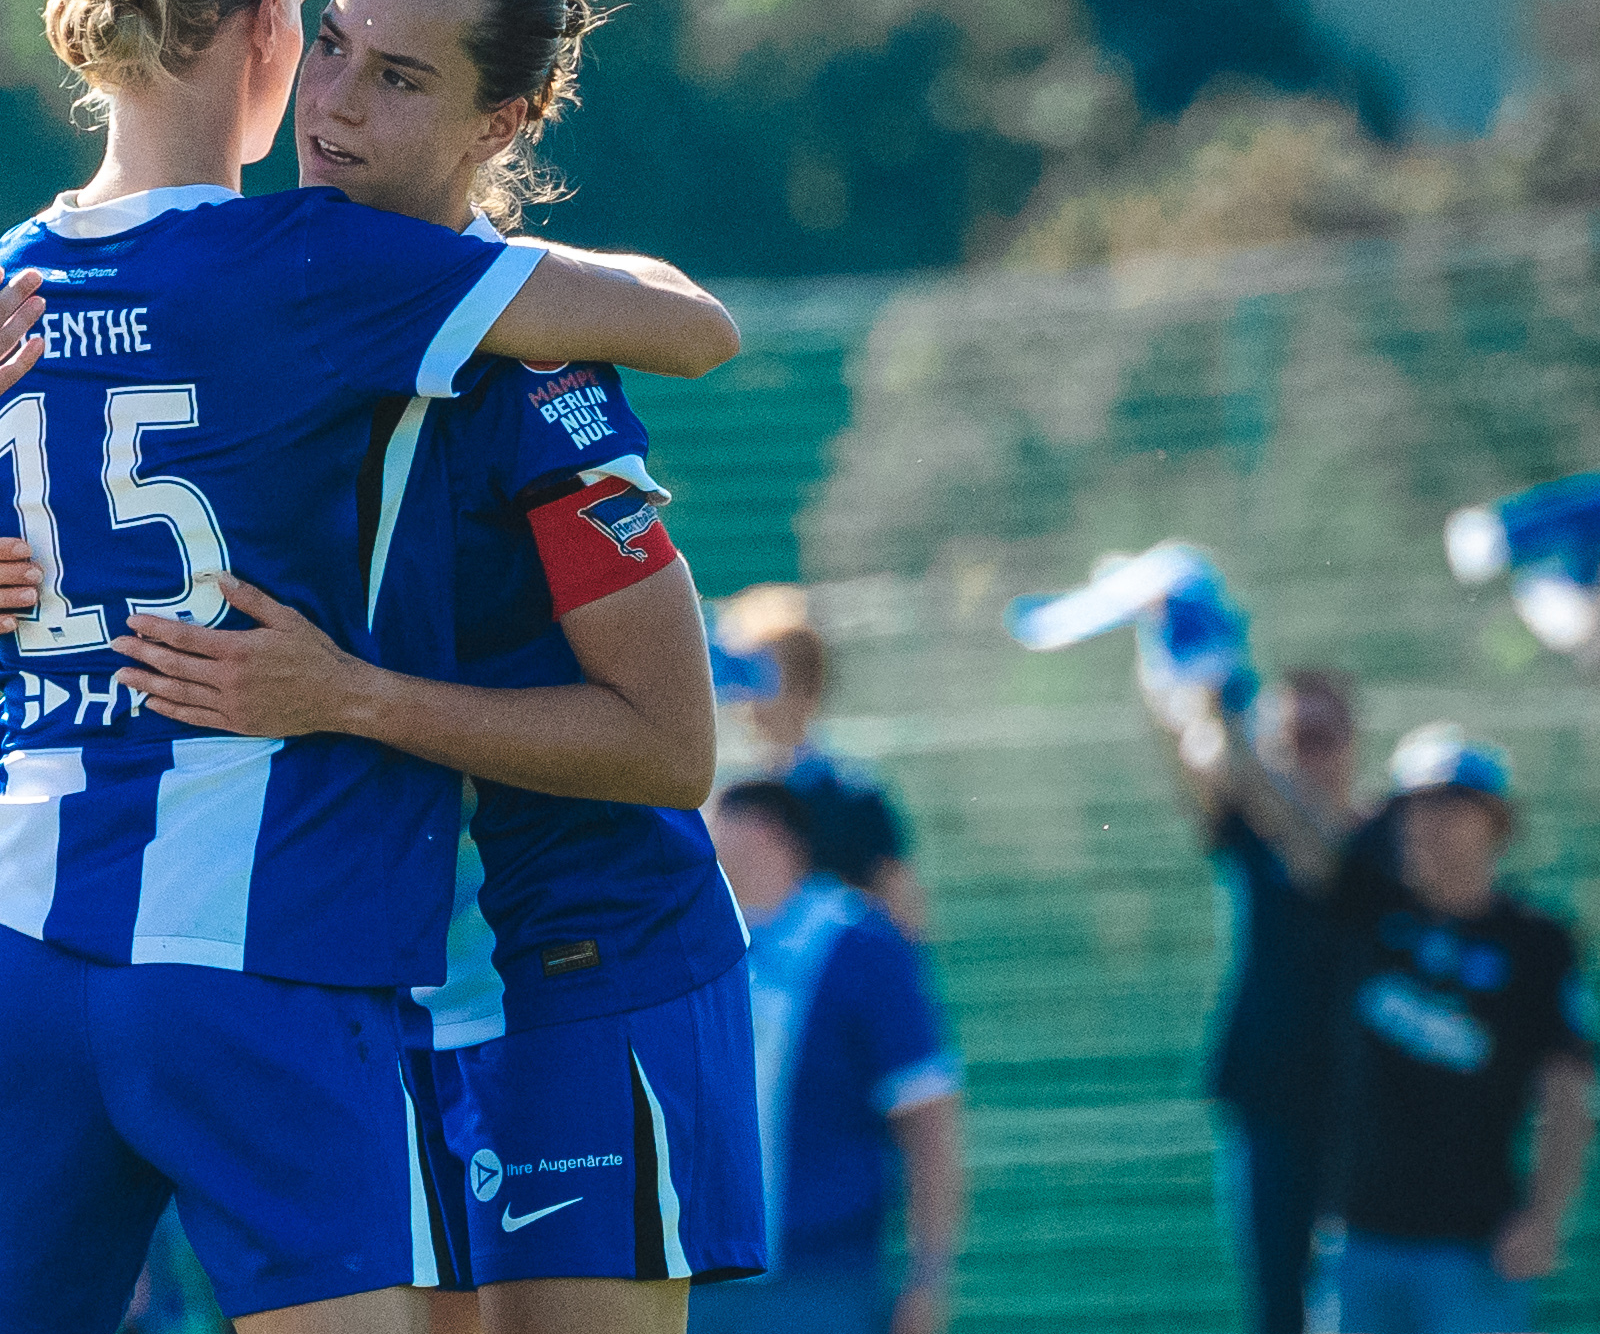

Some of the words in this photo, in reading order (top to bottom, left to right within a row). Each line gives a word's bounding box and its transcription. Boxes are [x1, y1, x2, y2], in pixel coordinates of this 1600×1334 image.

[20, 308, 152, 359] ENTHE
[540, 385, 608, 424] BERLIN
[74, 674, 149, 726] HY
[506, 1163, 533, 1177] Ihre
[538, 1153, 623, 1173] Augenärzte
